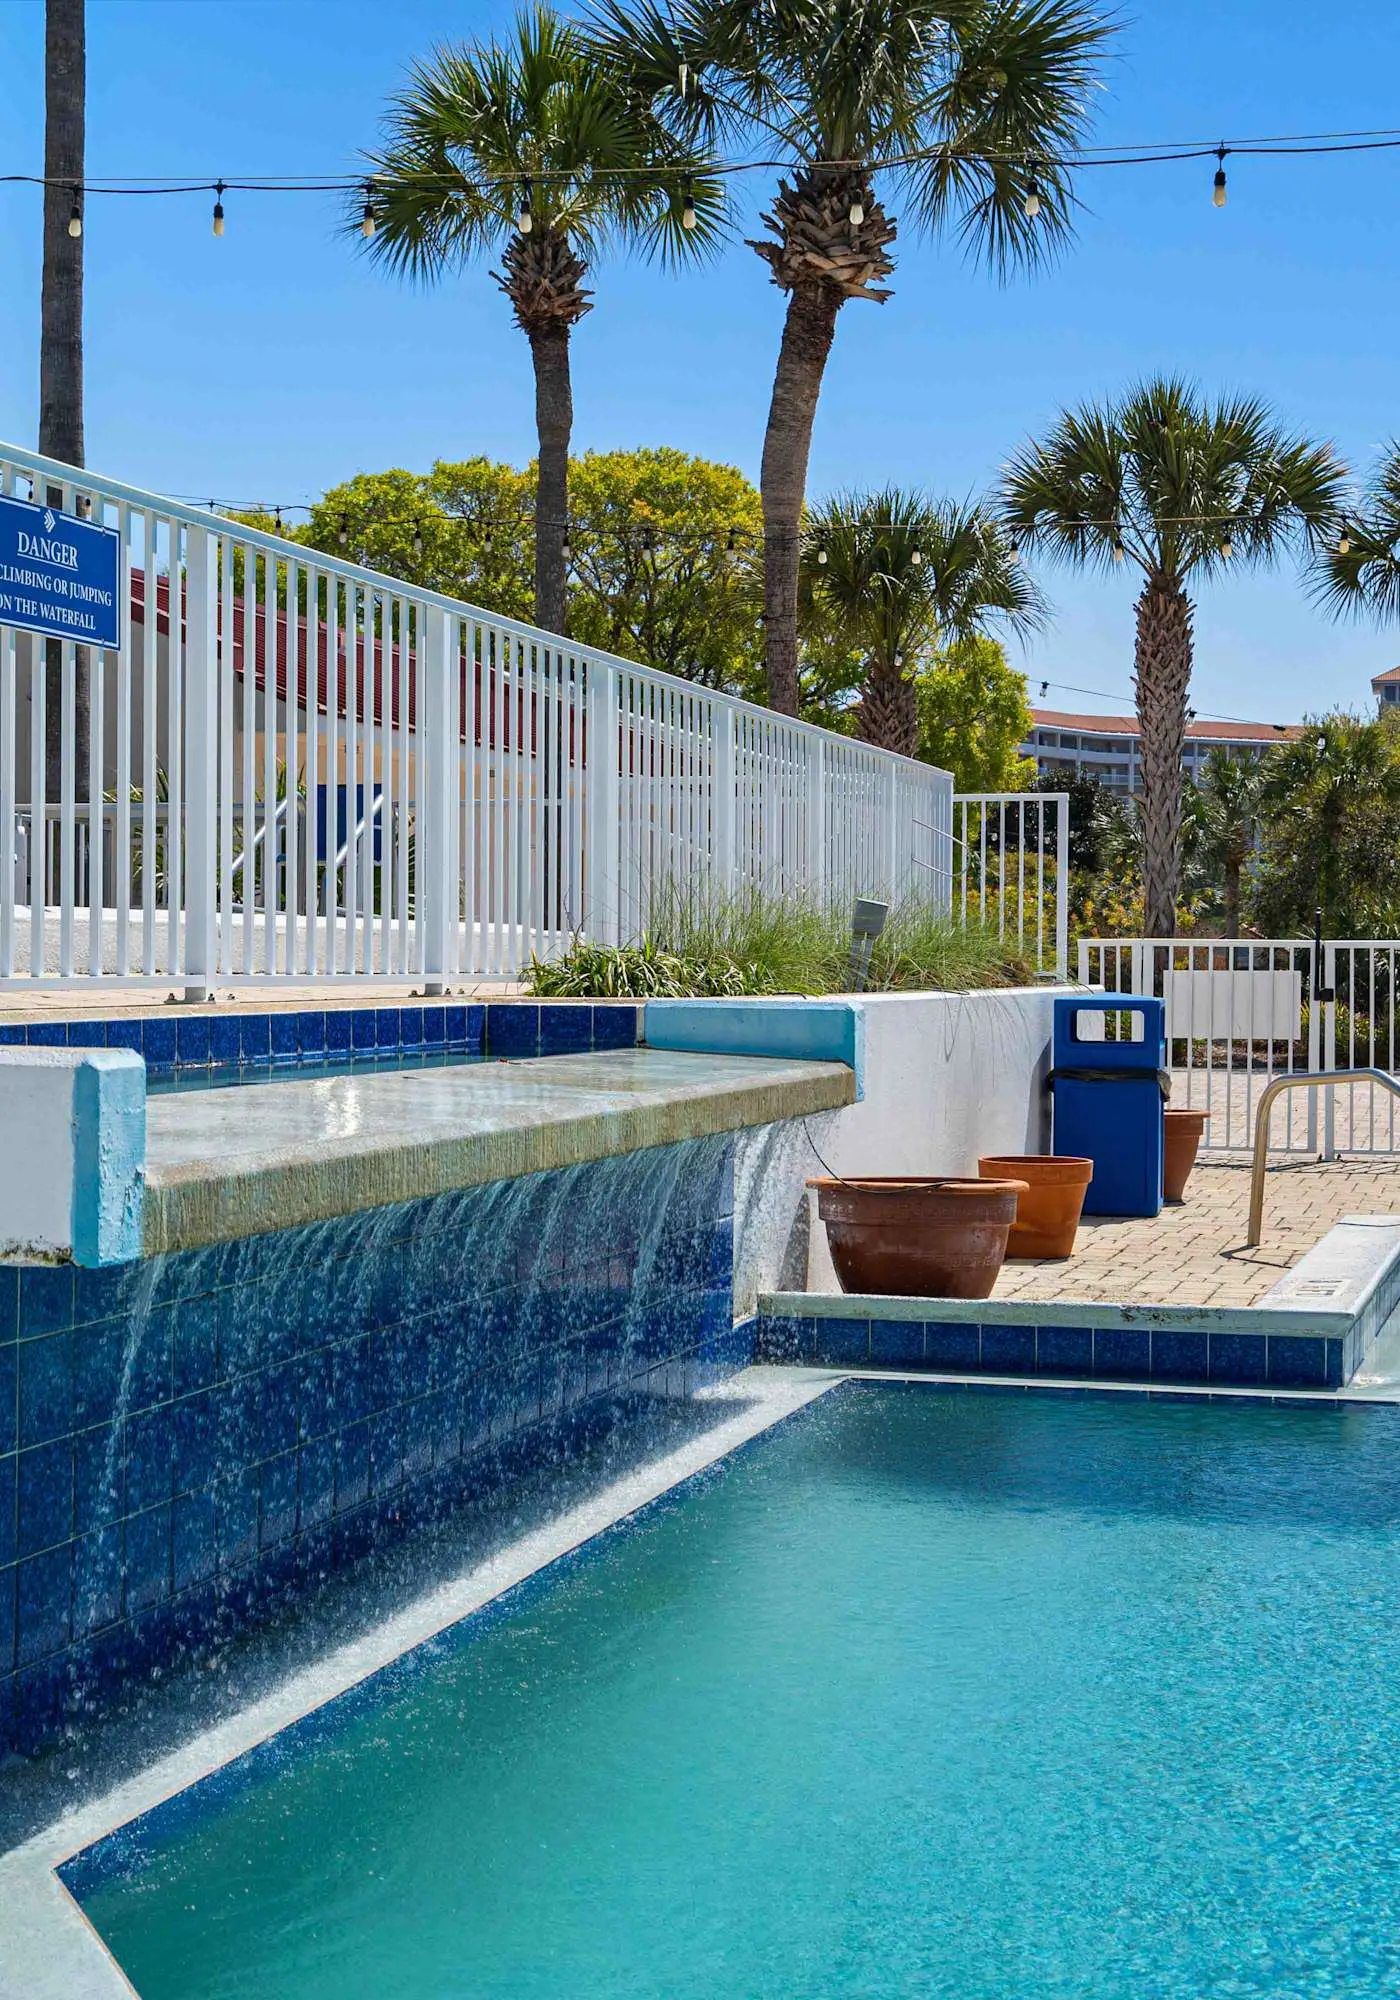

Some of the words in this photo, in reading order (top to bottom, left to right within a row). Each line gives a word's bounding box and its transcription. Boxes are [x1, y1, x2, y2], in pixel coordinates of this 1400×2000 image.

[17, 531, 78, 568] DANGER
[53, 577, 68, 595] OR
[69, 581, 112, 607] JUMPING
[14, 596, 38, 617] THE
[39, 602, 97, 630] WATERFALL
